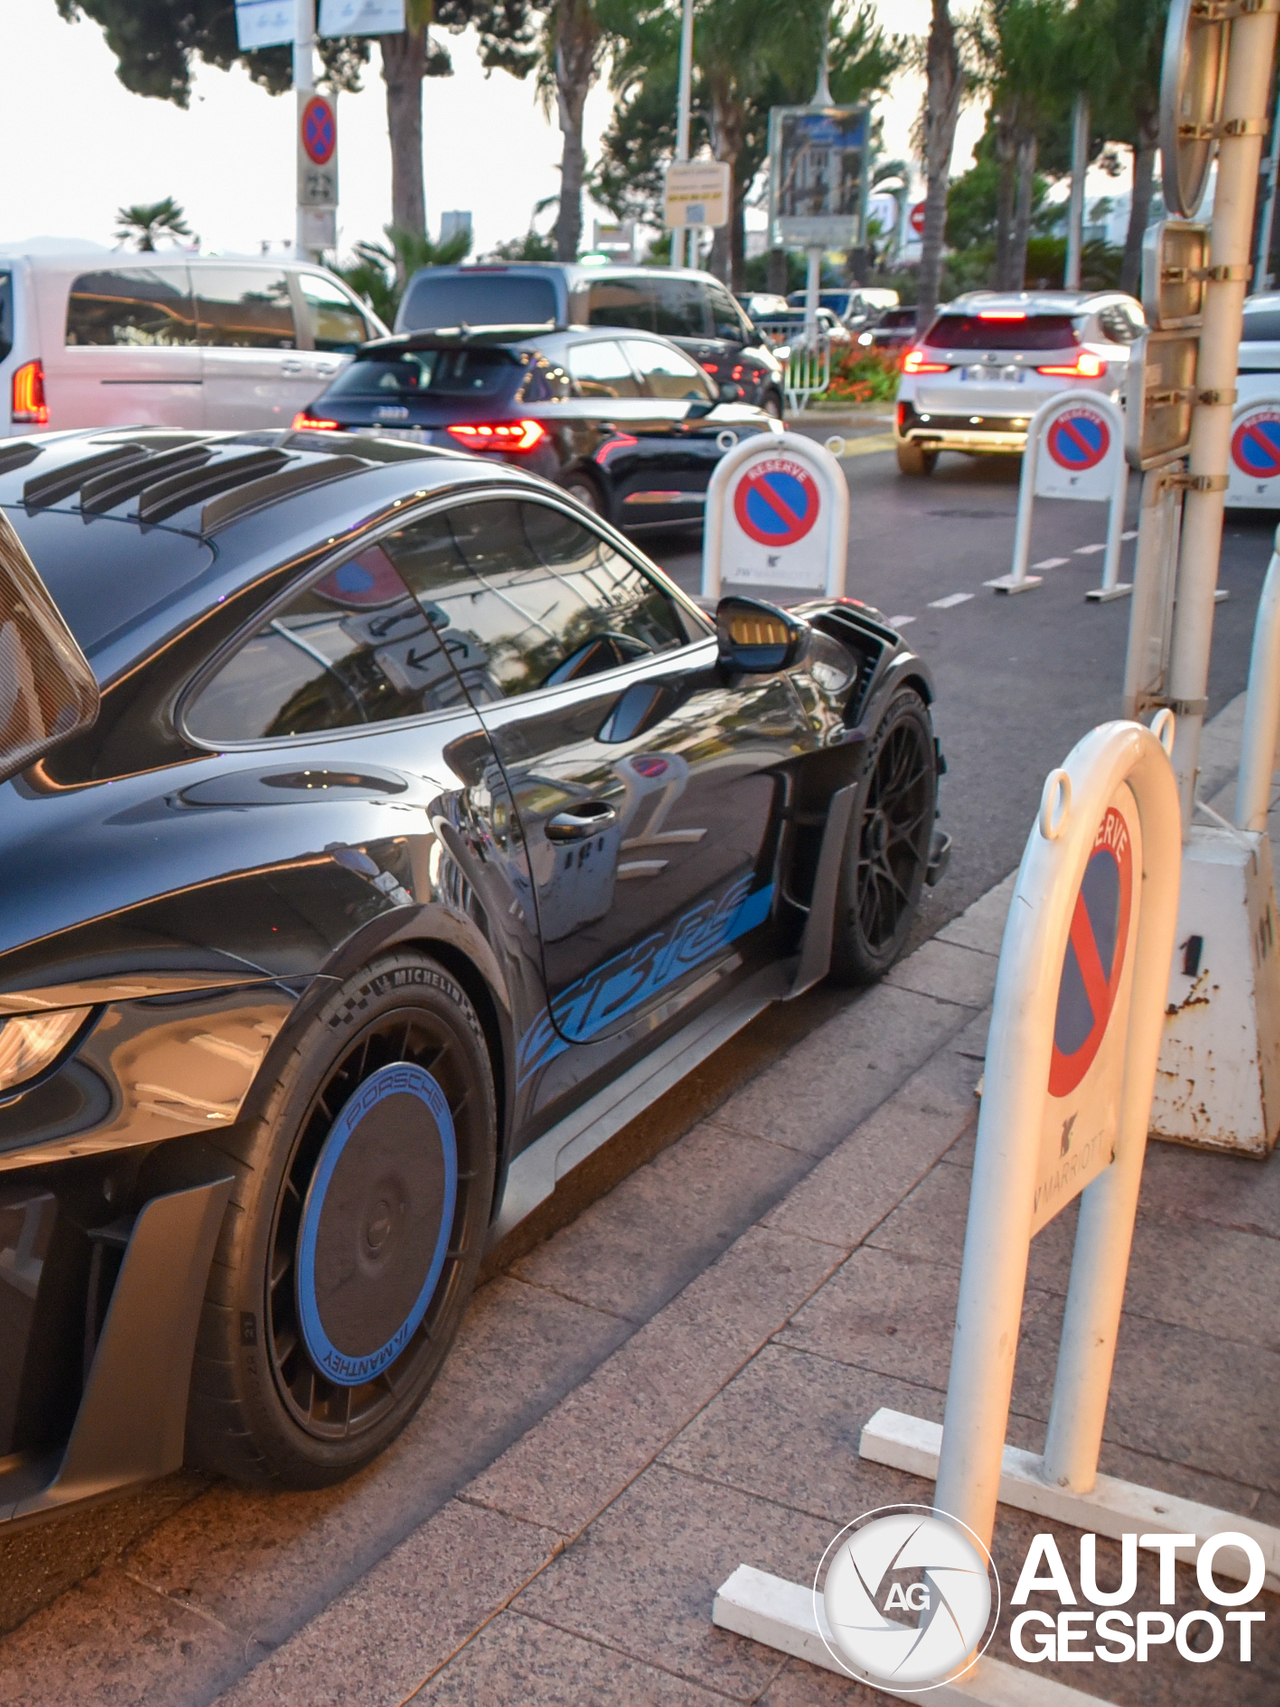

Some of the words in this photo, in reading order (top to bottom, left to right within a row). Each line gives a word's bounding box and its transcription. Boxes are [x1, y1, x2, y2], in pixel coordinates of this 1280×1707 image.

[747, 460, 808, 483] RESERVE
[1095, 814, 1128, 864] ERVE
[394, 968, 462, 1005] MICHELIN
[347, 1073, 445, 1131] PORSCHE
[323, 1343, 394, 1377] MANTHEY
